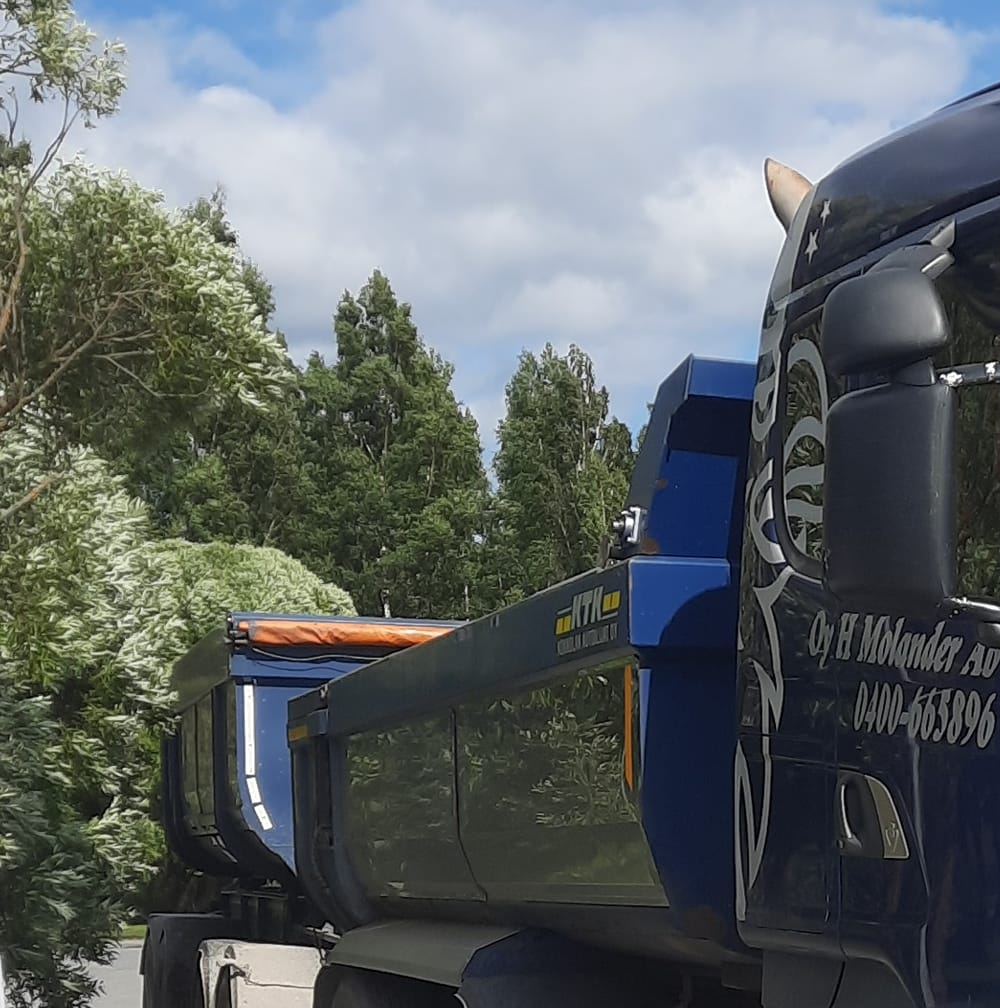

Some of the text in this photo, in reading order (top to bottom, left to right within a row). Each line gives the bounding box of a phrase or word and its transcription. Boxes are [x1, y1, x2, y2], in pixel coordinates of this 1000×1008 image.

[808, 609, 834, 670] Oy
[835, 612, 860, 661] H
[857, 615, 964, 674] Molander
[854, 681, 998, 749] 0400-665896
